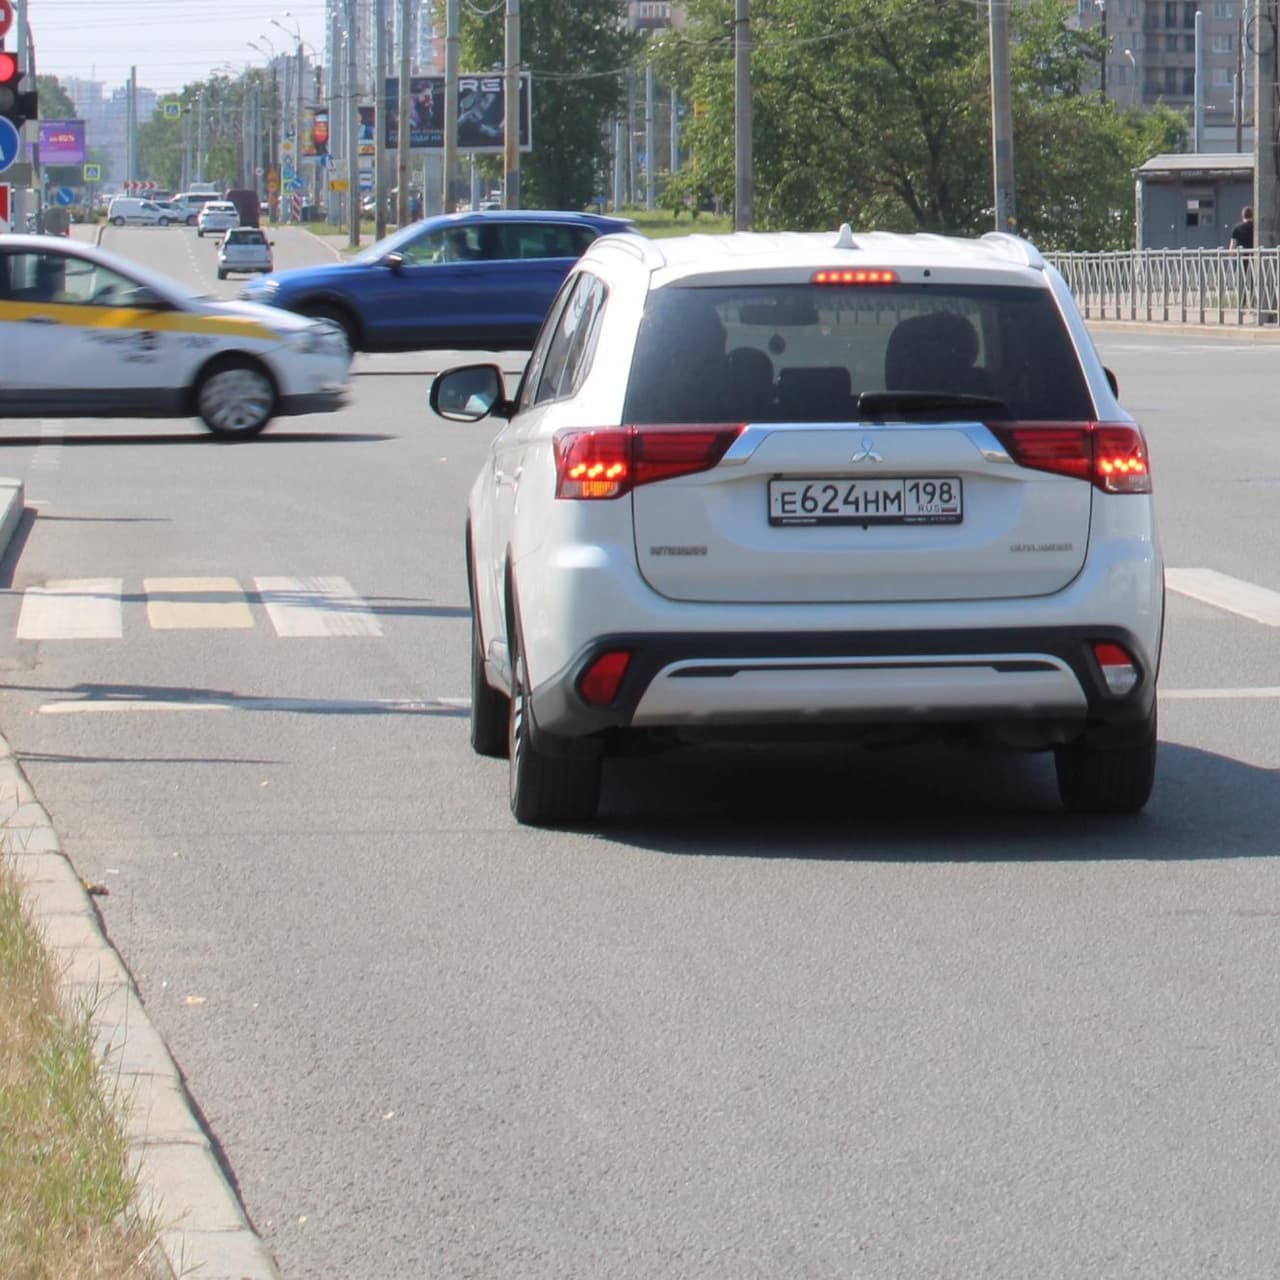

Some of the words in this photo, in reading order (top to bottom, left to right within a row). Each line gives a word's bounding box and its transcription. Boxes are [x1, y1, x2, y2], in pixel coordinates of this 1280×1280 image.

[781, 483, 902, 514] Е624НМ
[908, 482, 953, 505] 198
[918, 505, 940, 513] RUS
